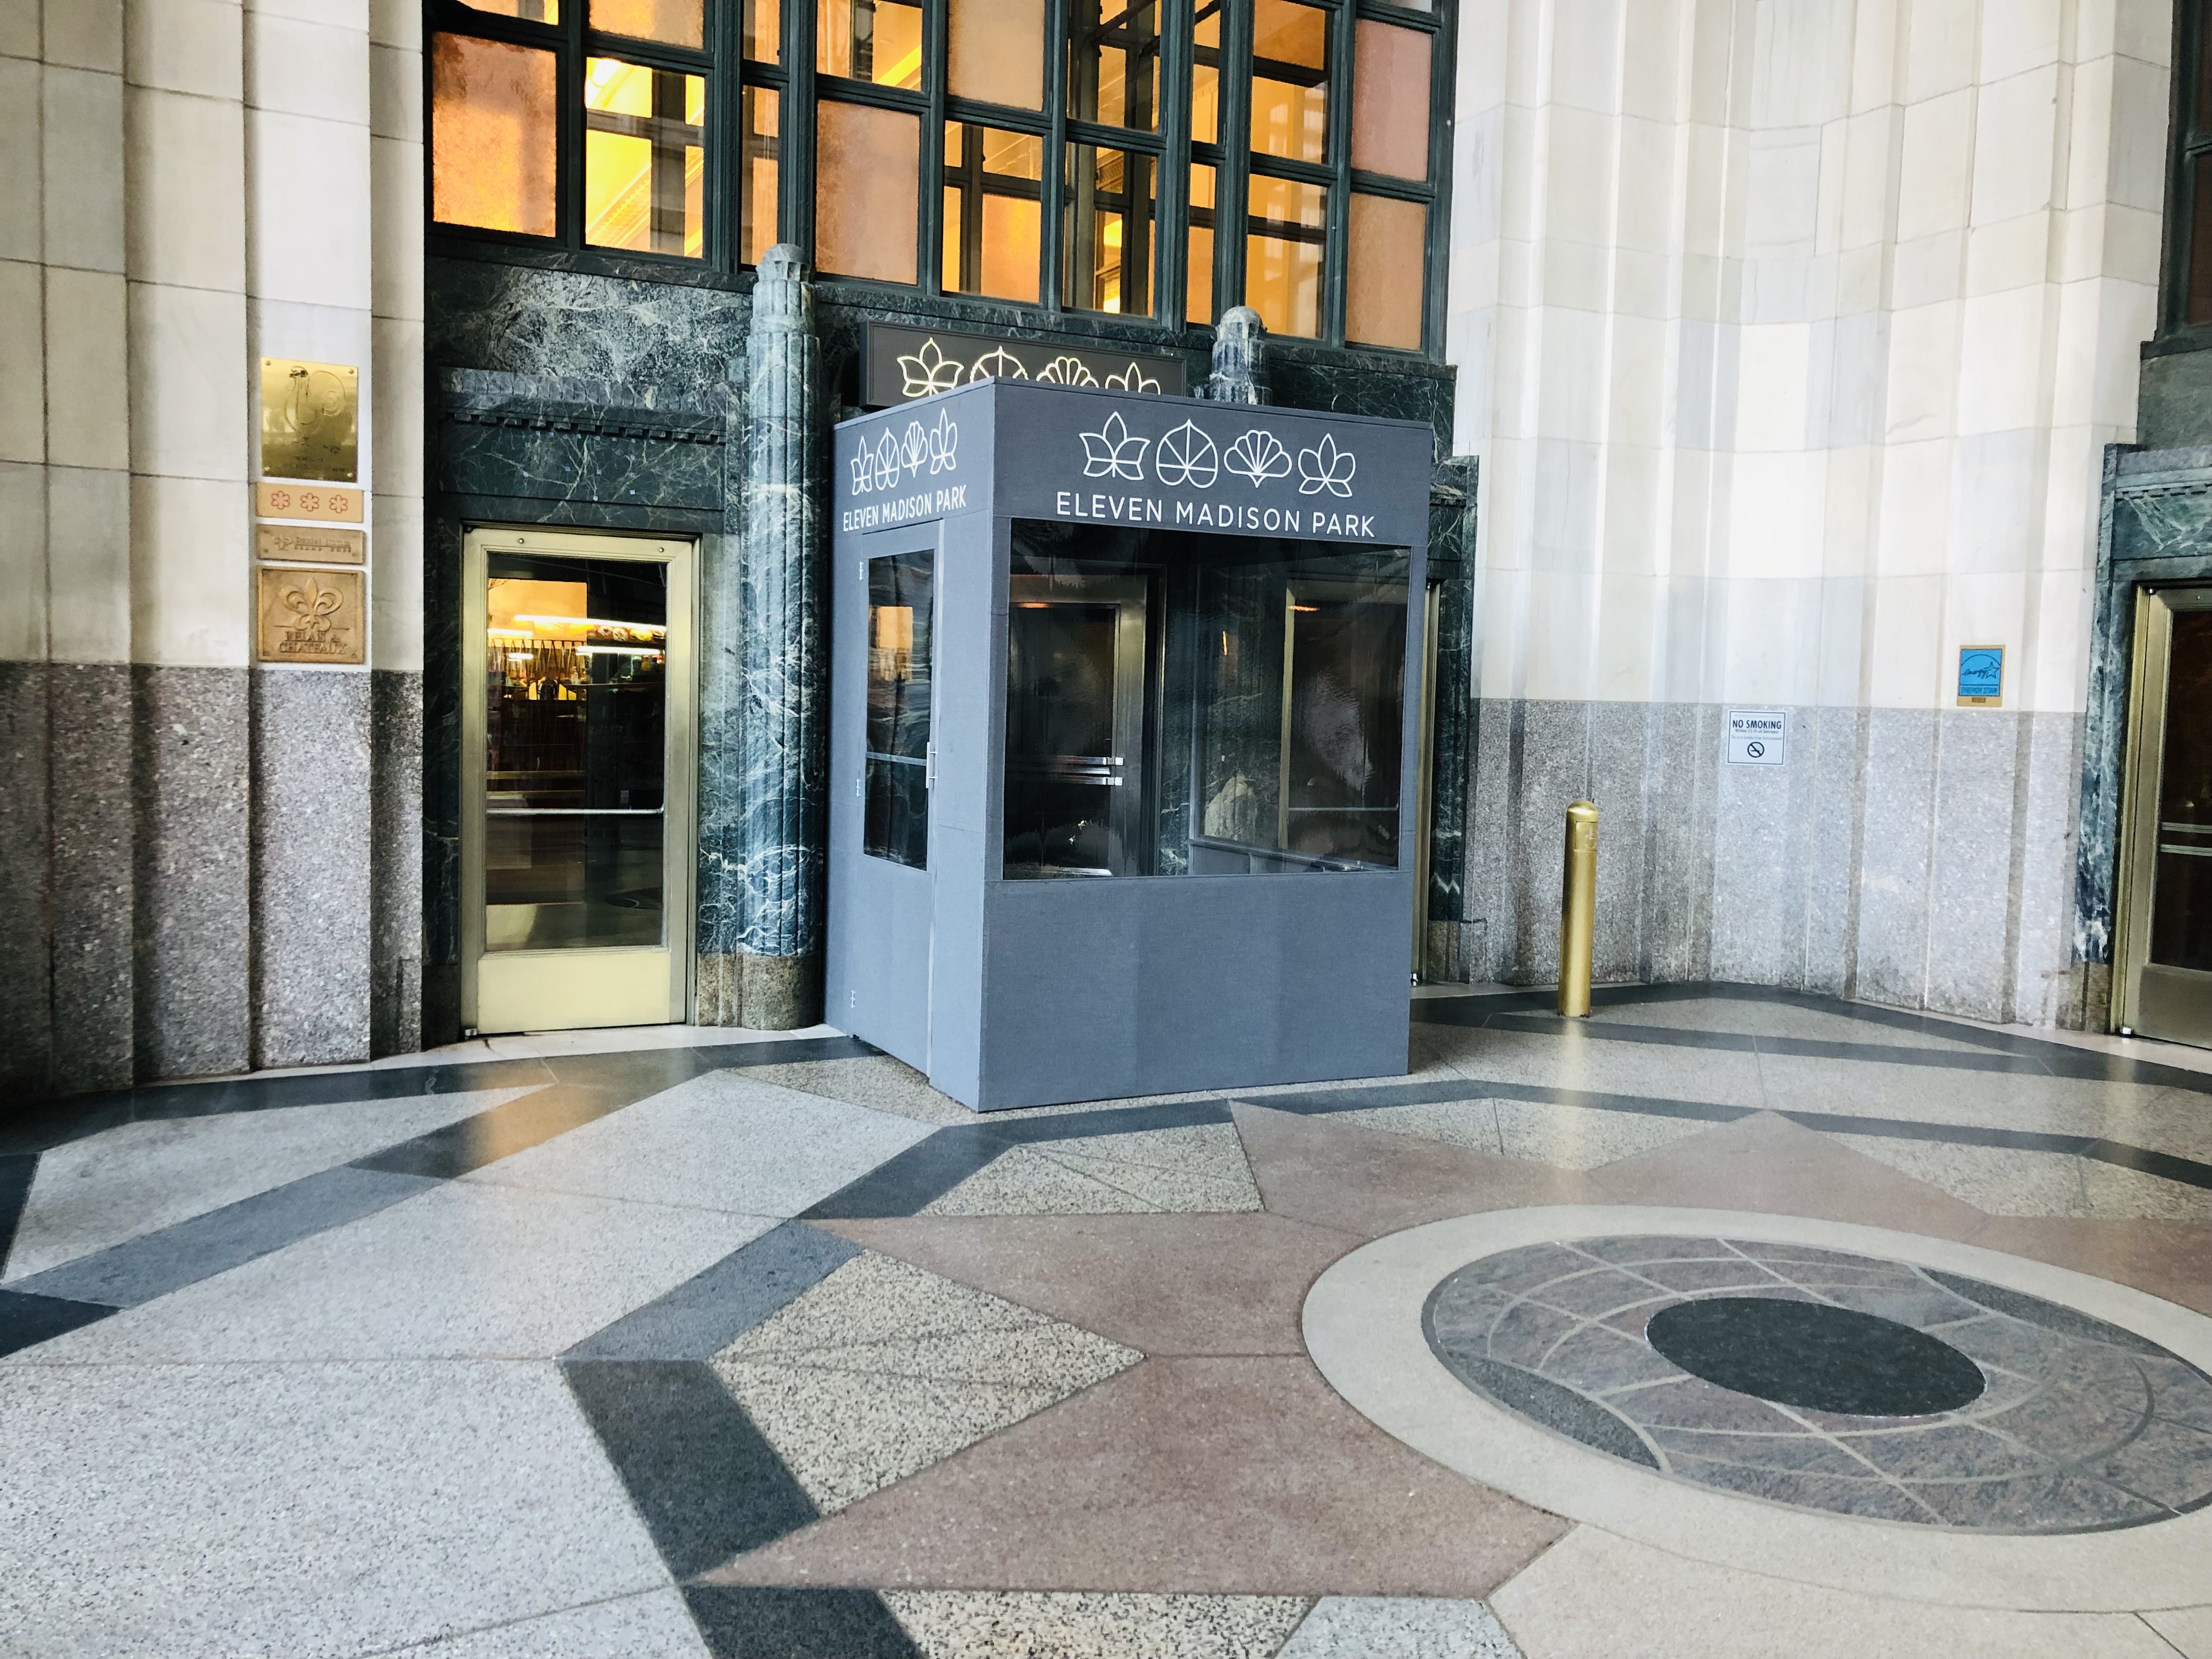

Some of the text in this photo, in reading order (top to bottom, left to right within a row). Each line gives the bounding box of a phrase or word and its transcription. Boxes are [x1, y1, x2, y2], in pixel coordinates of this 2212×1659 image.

[843, 484, 967, 532] ELEVEN MADISON PARK
[1057, 492, 1375, 538] ELEVEN MADISON PARK
[285, 631, 327, 642] RELAIS
[1733, 719, 1781, 729] NO SMOKING
